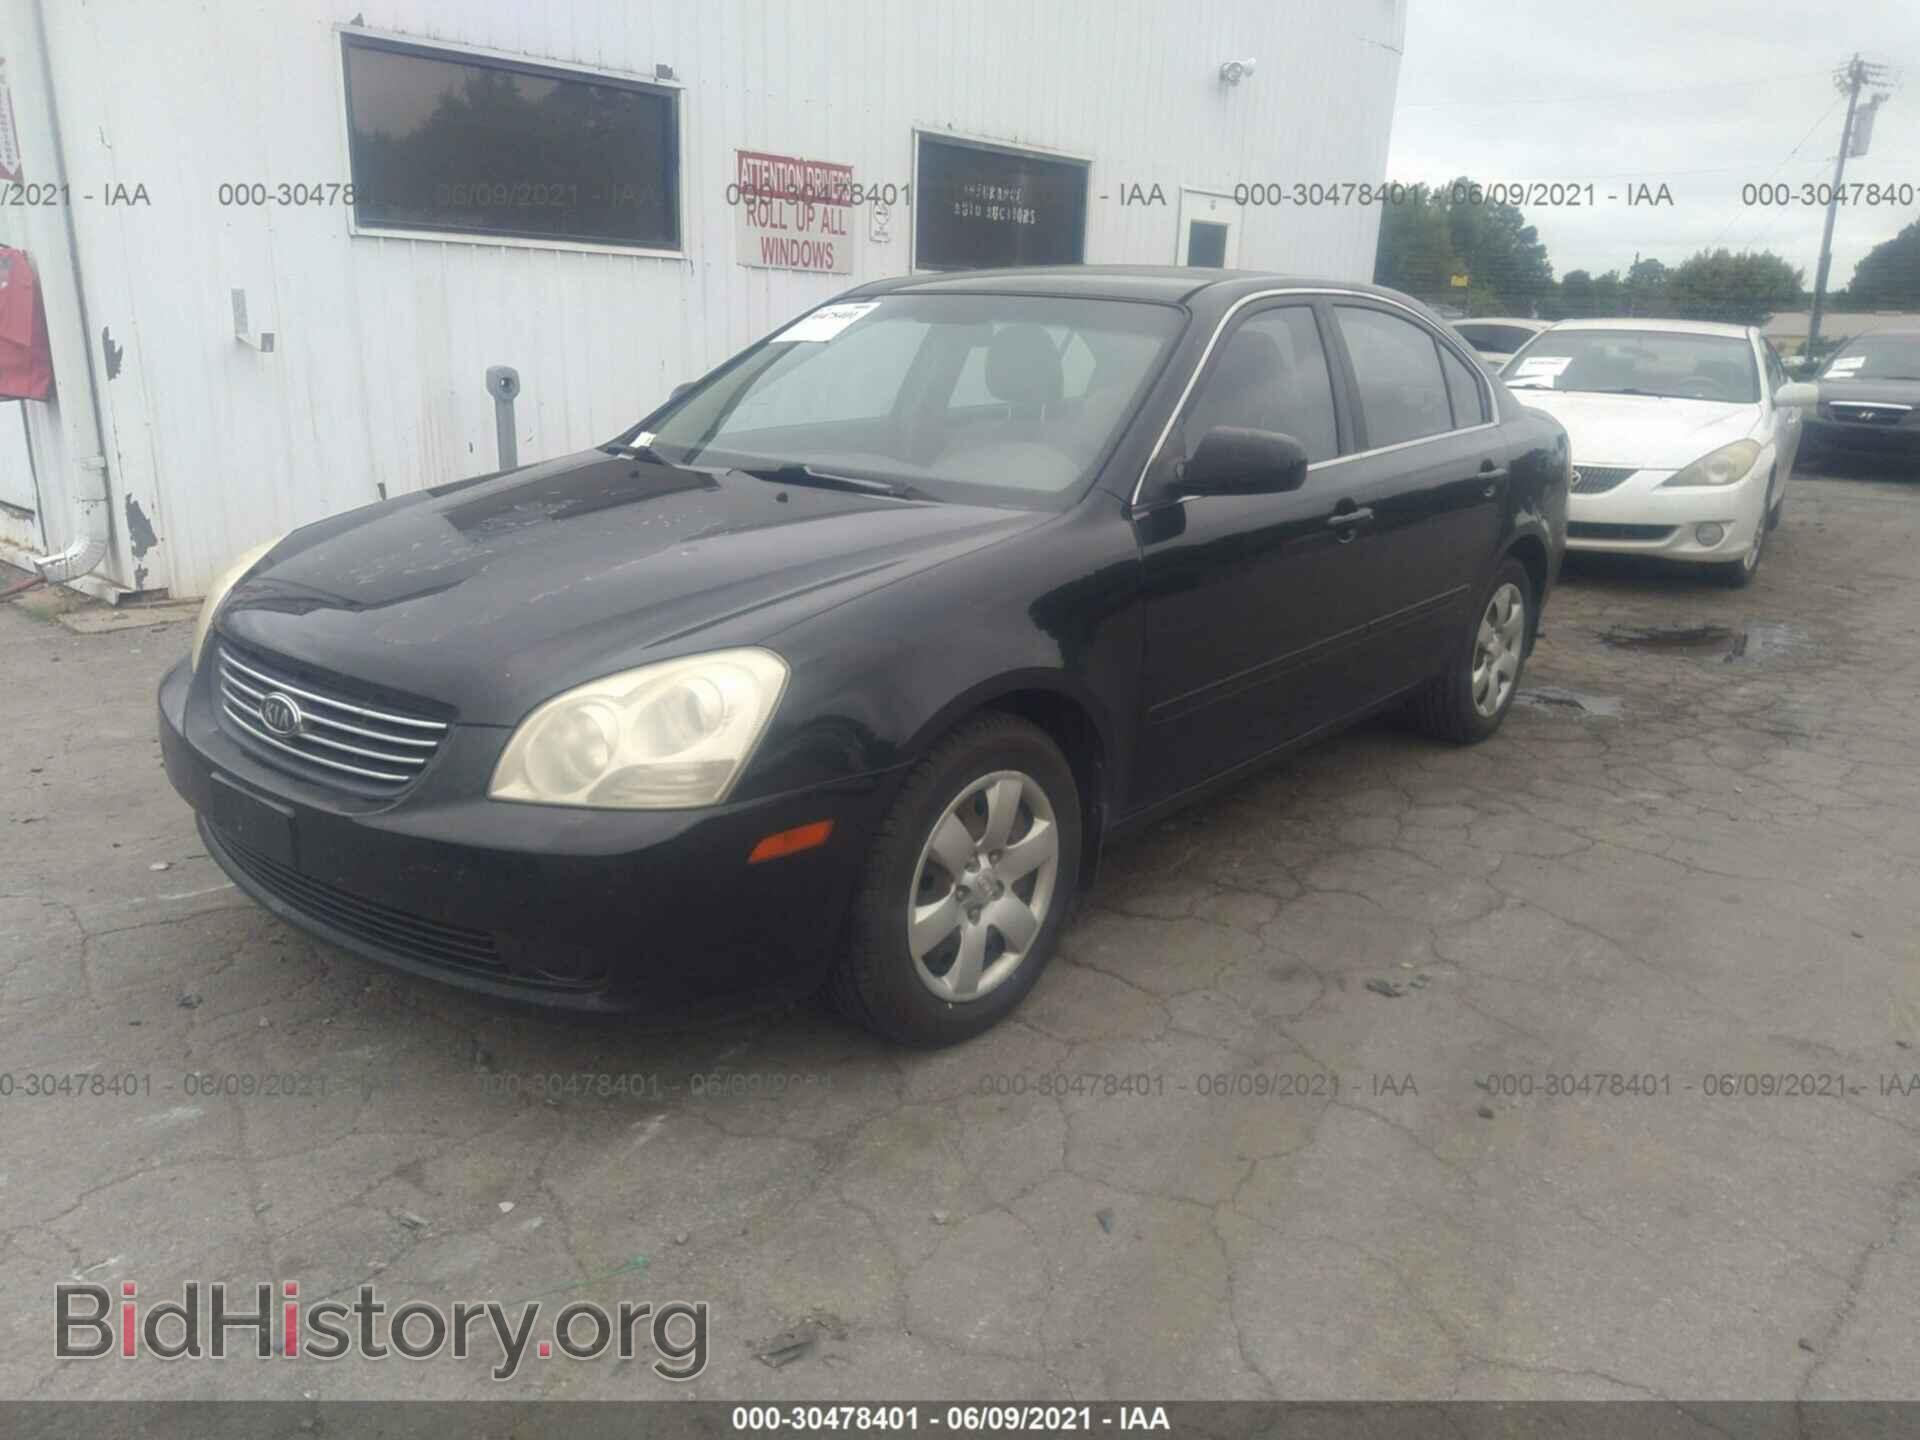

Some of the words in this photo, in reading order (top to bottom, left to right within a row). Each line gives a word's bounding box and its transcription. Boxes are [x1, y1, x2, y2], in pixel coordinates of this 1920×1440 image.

[740, 157, 802, 198] ATTENTION
[806, 166, 851, 202] DRIVERS
[746, 198, 788, 230] ROLL
[795, 202, 816, 232] UP
[820, 206, 847, 236] ALL
[760, 236, 835, 270] WINDOWS
